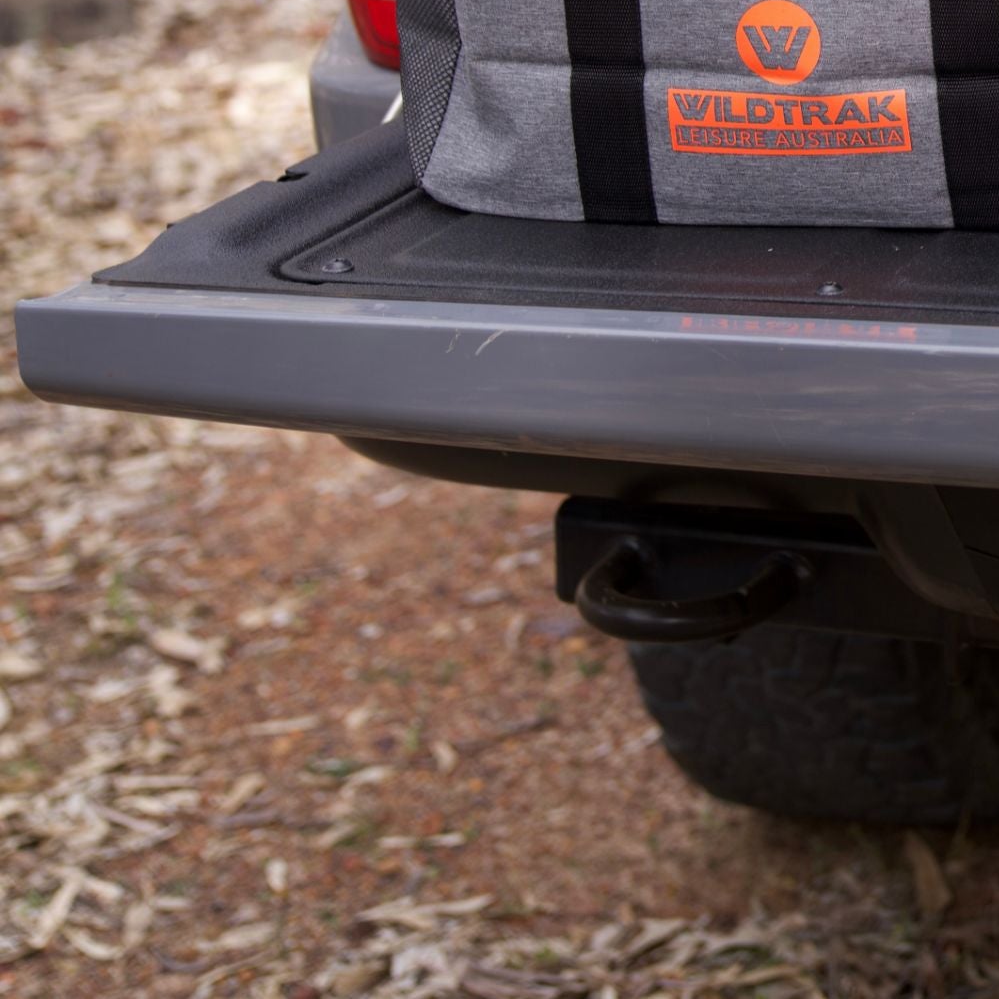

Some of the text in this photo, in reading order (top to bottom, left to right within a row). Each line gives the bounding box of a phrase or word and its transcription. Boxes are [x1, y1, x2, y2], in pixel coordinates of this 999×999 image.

[673, 93, 901, 125] WILDTRAK
[677, 127, 904, 147] LEISURE AUSTRALIA
